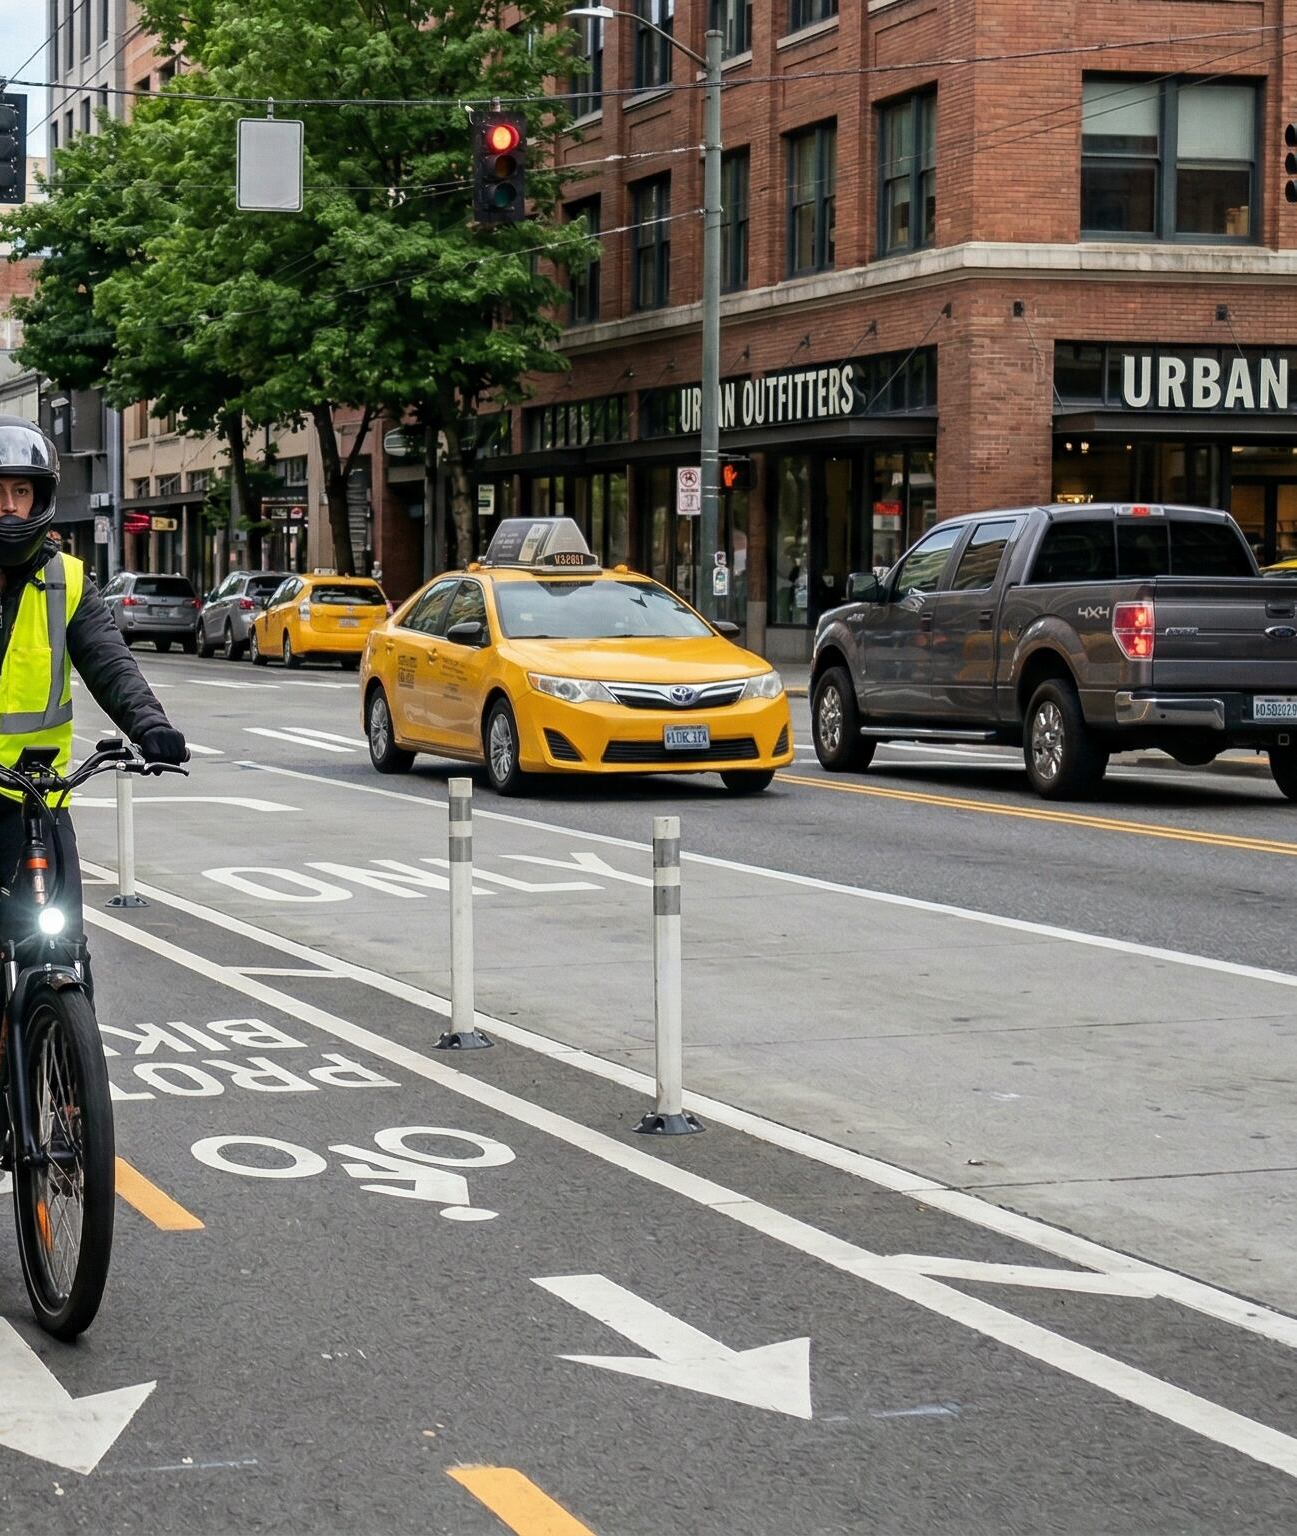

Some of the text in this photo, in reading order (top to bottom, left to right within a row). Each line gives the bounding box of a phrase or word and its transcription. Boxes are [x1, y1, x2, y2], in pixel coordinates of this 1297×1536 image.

[680, 364, 854, 432] URAN OUTFITTERS
[1123, 355, 1288, 409] URBAN
[201, 852, 653, 902] ONLY
[97, 1019, 309, 1056] BIK
